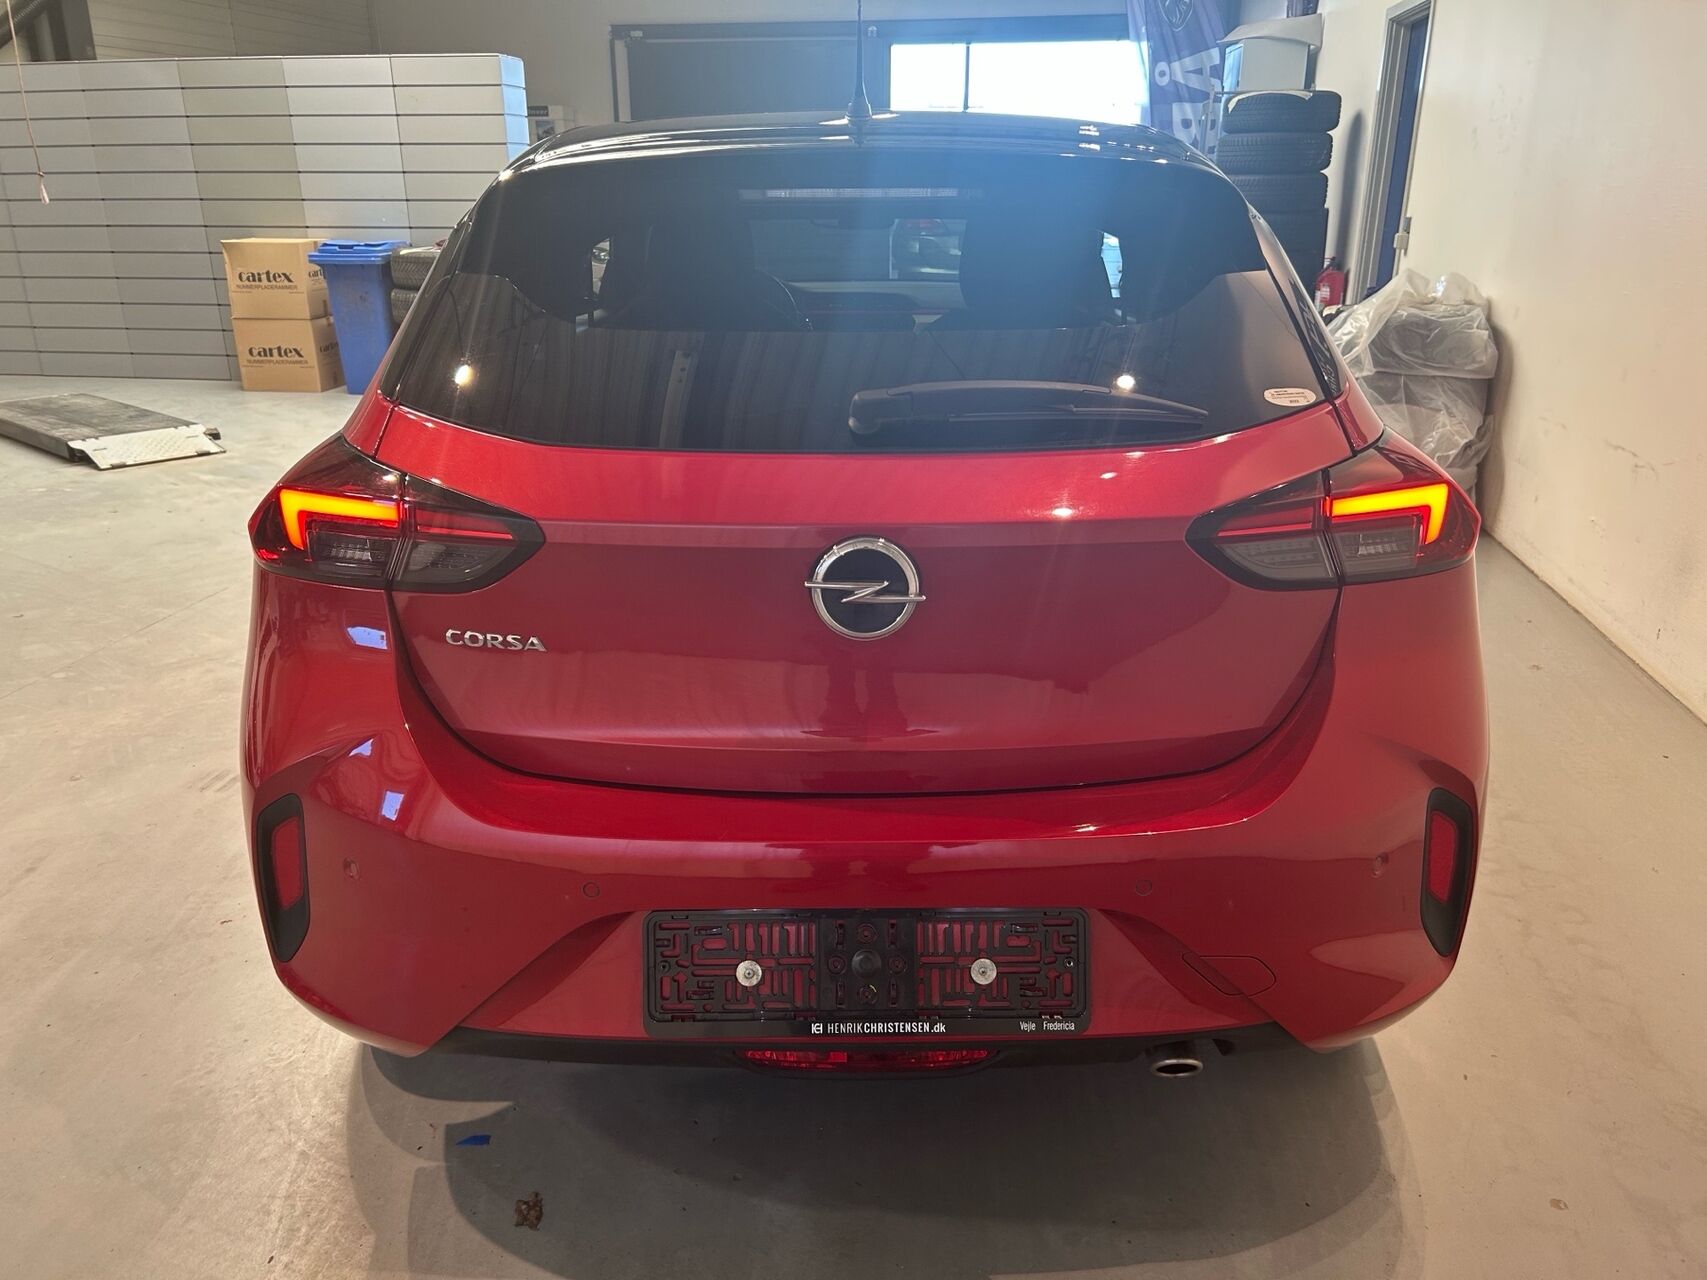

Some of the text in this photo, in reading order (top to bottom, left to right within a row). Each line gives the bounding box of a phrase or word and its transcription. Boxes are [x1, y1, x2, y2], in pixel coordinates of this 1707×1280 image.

[238, 269, 294, 283] cartex
[248, 345, 304, 358] cartex
[445, 628, 547, 652] CORSA
[827, 1022, 946, 1034] HENRIKCHRISTENSEN.dk
[1020, 1021, 1075, 1032] Vejle Fredericia
